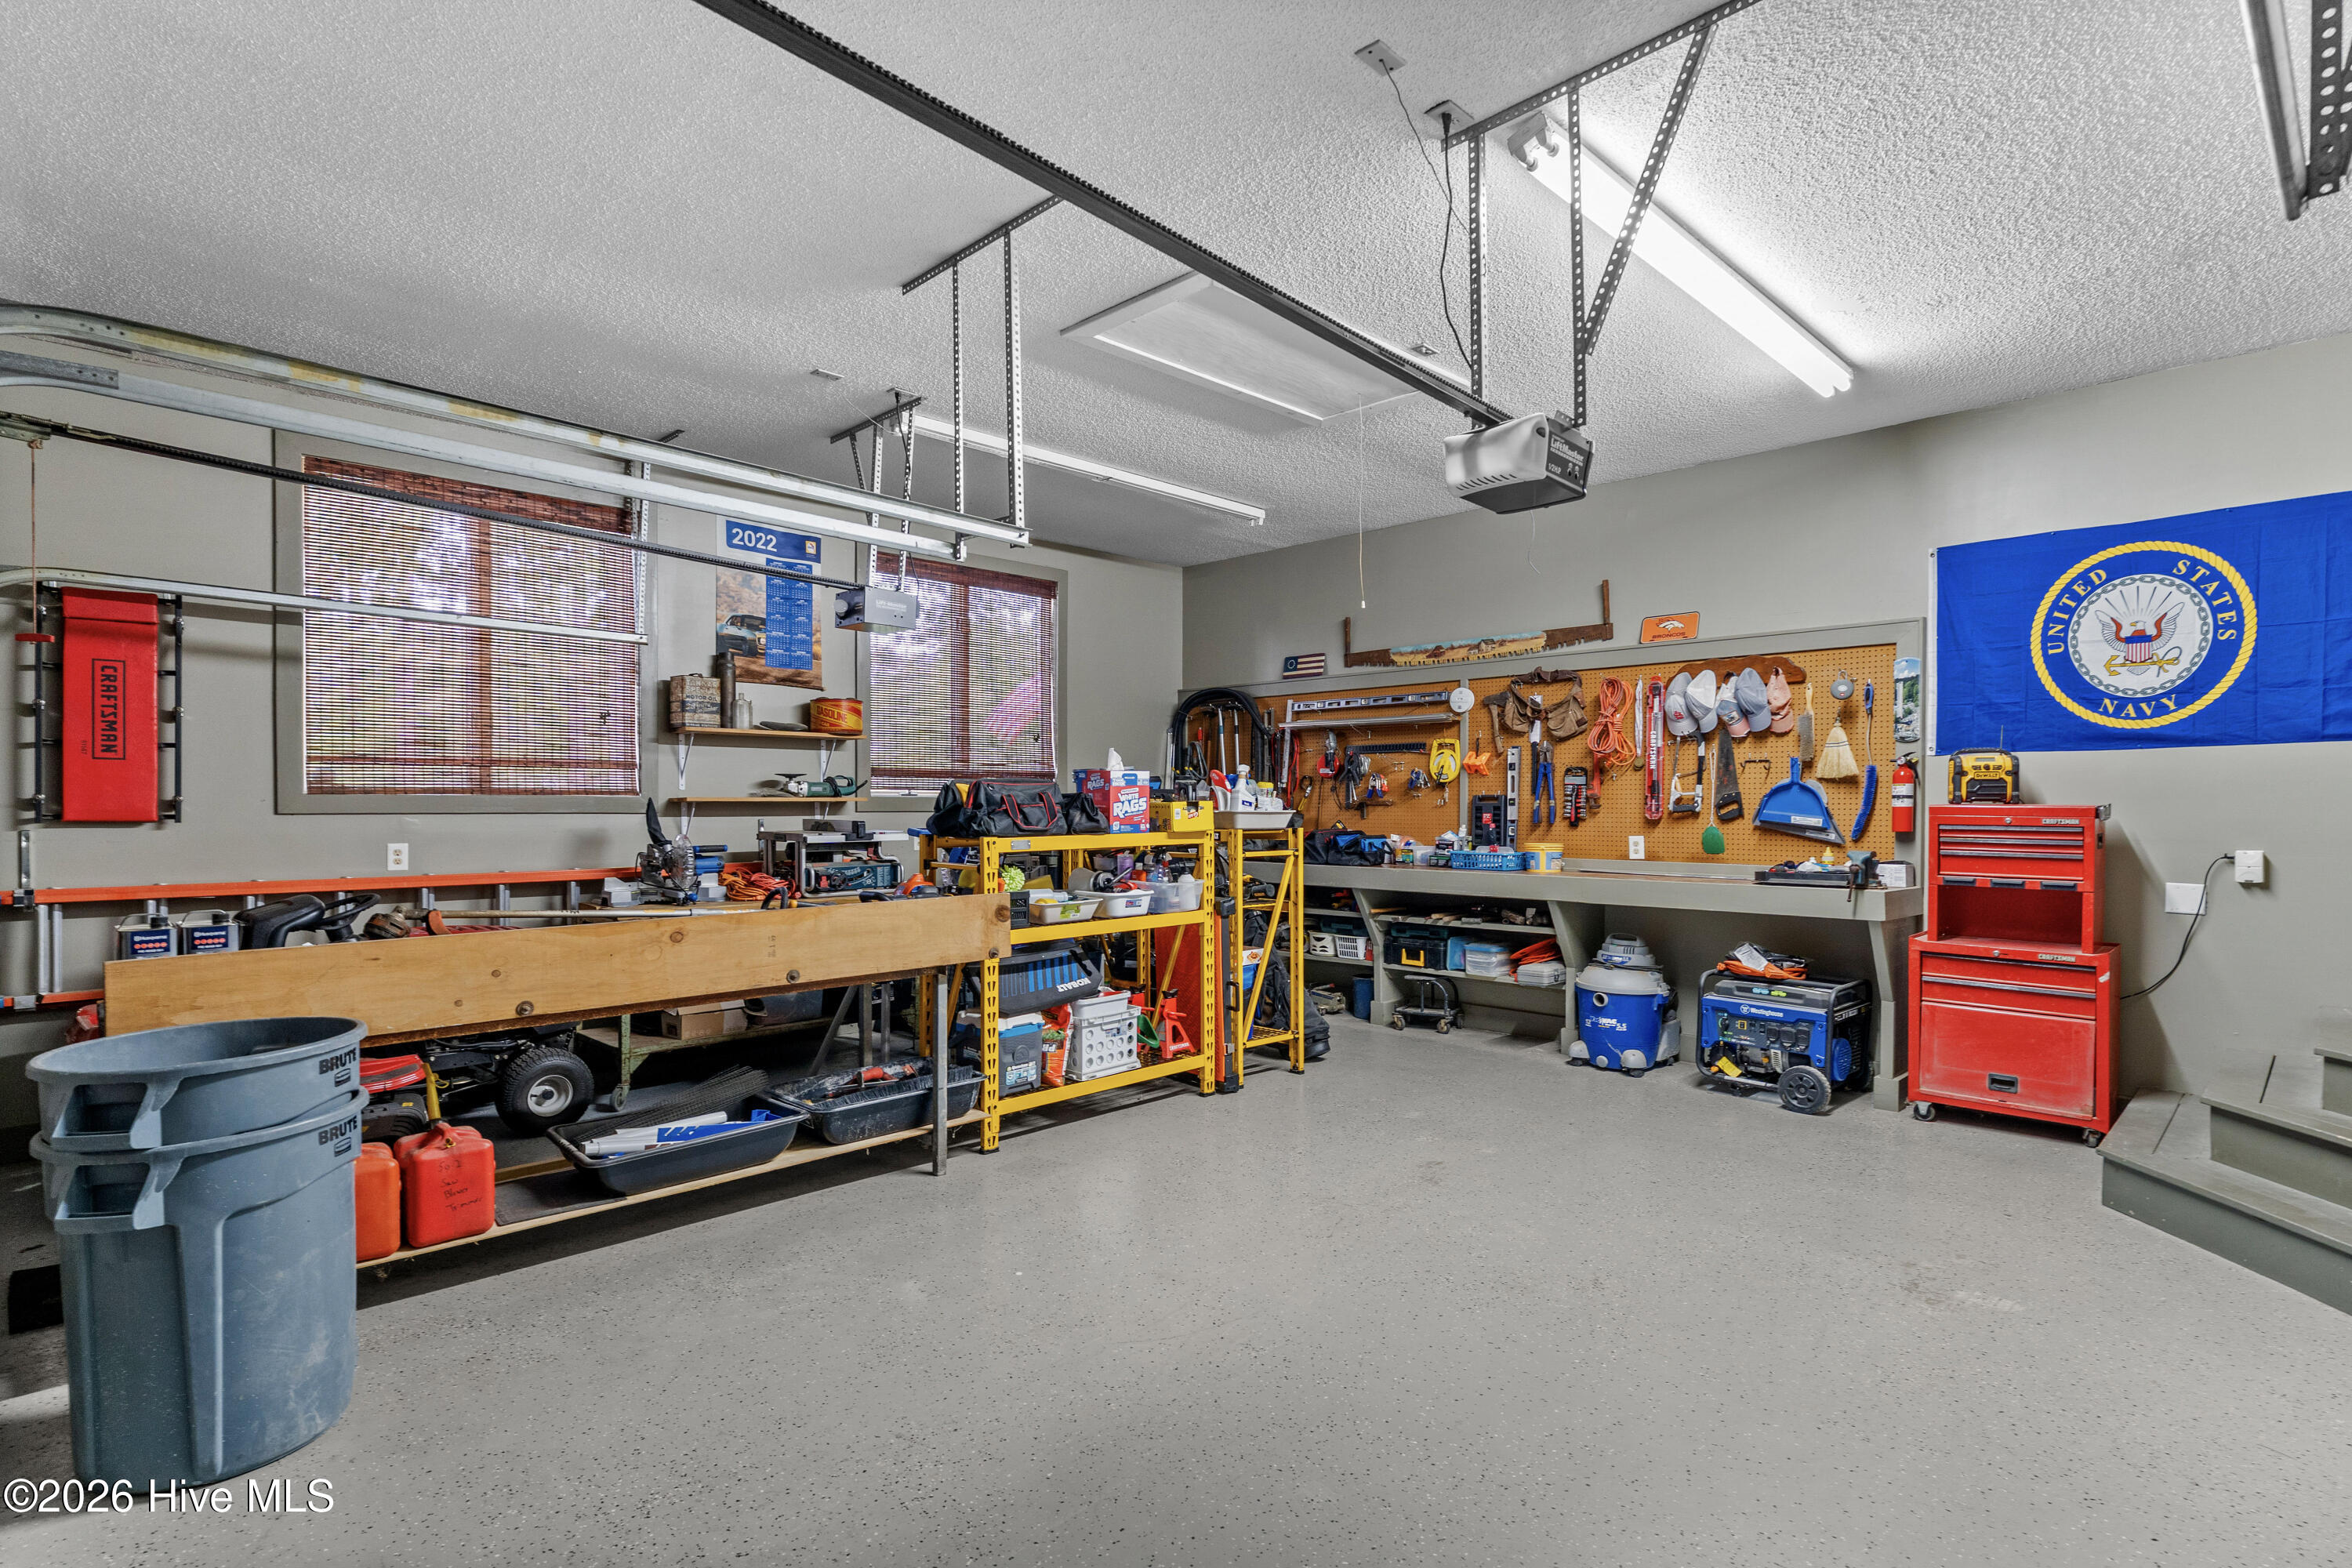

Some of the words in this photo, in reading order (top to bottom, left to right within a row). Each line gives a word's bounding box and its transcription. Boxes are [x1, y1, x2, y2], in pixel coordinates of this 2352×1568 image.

[731, 528, 777, 552] 2022
[2048, 568, 2107, 655] UNITED
[2172, 559, 2237, 641] STATES
[100, 665, 118, 753] CRAFTSMAN
[816, 705, 848, 724] GASOLINE
[2099, 694, 2178, 717] NAVY
[1087, 779, 1105, 790] RAGS
[1113, 797, 1148, 818] RAGS
[1118, 793, 1139, 802] WHITE
[1056, 977, 1091, 992] KOBALT
[1751, 1007, 1784, 1017] Westinghouse
[319, 1047, 357, 1075] BRUTE
[318, 1115, 358, 1145] BRUTE
